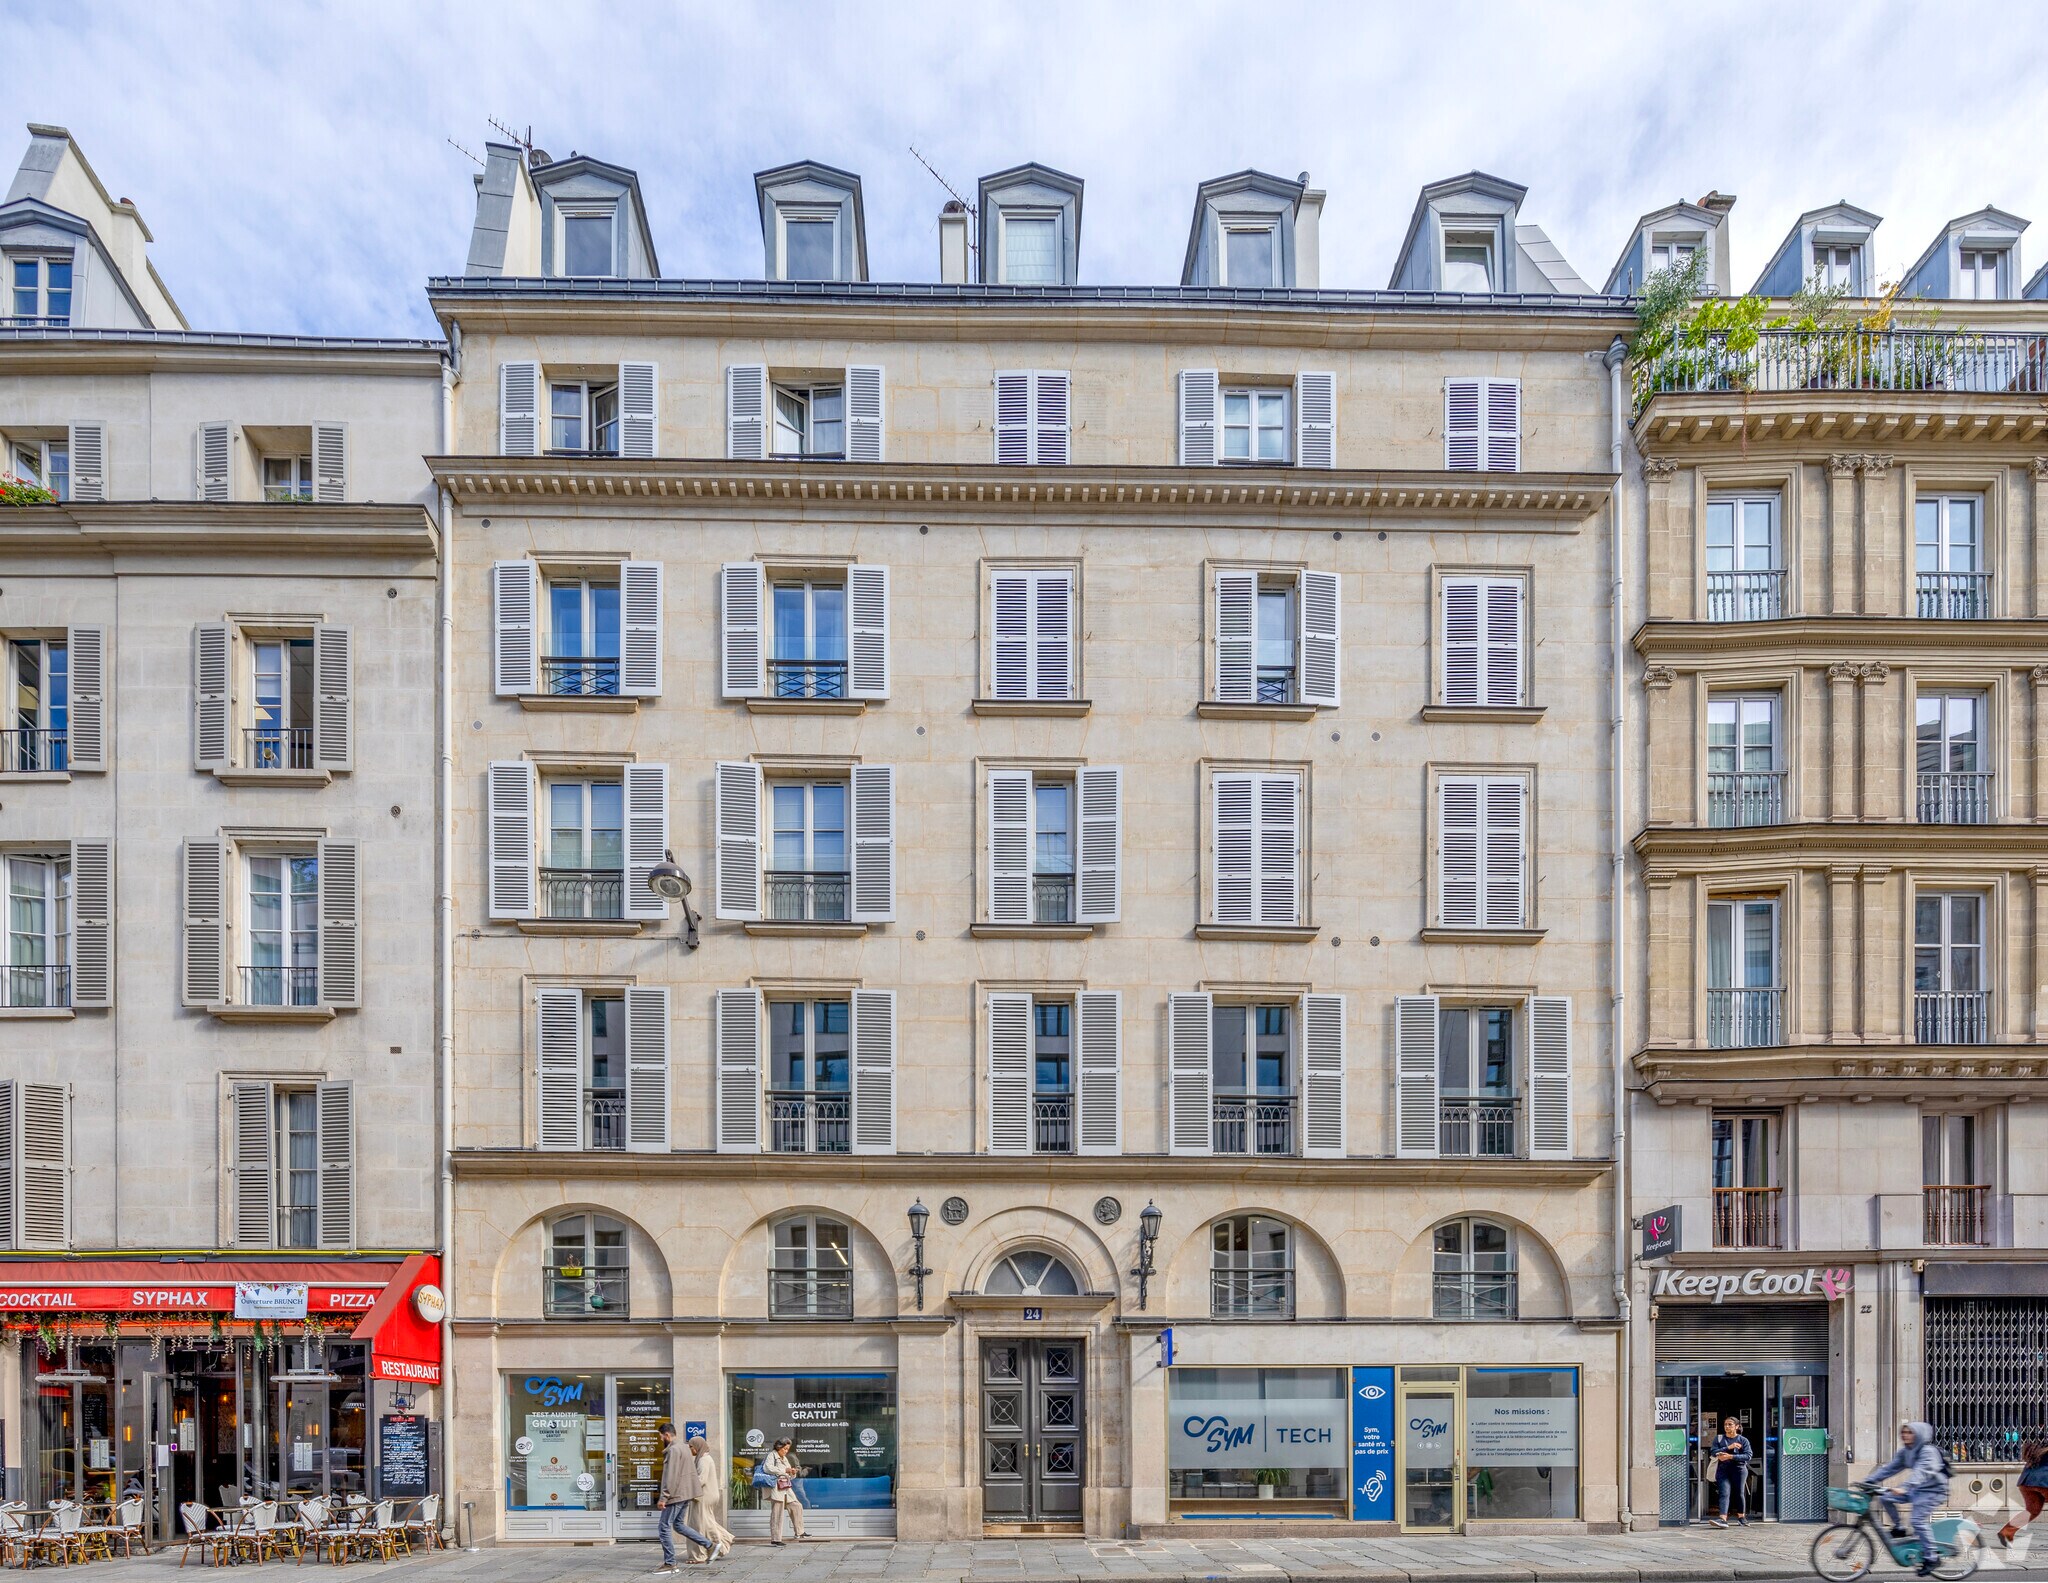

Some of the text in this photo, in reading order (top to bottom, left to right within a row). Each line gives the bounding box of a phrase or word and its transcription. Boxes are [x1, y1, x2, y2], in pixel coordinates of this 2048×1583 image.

[0, 1294, 76, 1306] COCKTAIL
[132, 1291, 208, 1306] SYPHAX
[330, 1294, 376, 1306] PIZZA
[418, 1292, 444, 1311] SYPHAX
[1026, 1308, 1040, 1320] 24
[1860, 1304, 1872, 1314] 22
[382, 1361, 440, 1380] RESTAURANT
[1658, 1400, 1682, 1410] SALLE
[791, 1411, 838, 1419] GRATUIT
[1660, 1412, 1683, 1422] SPORT
[1422, 1422, 1447, 1438] SYM
[1206, 1424, 1332, 1452] SYM TECH
